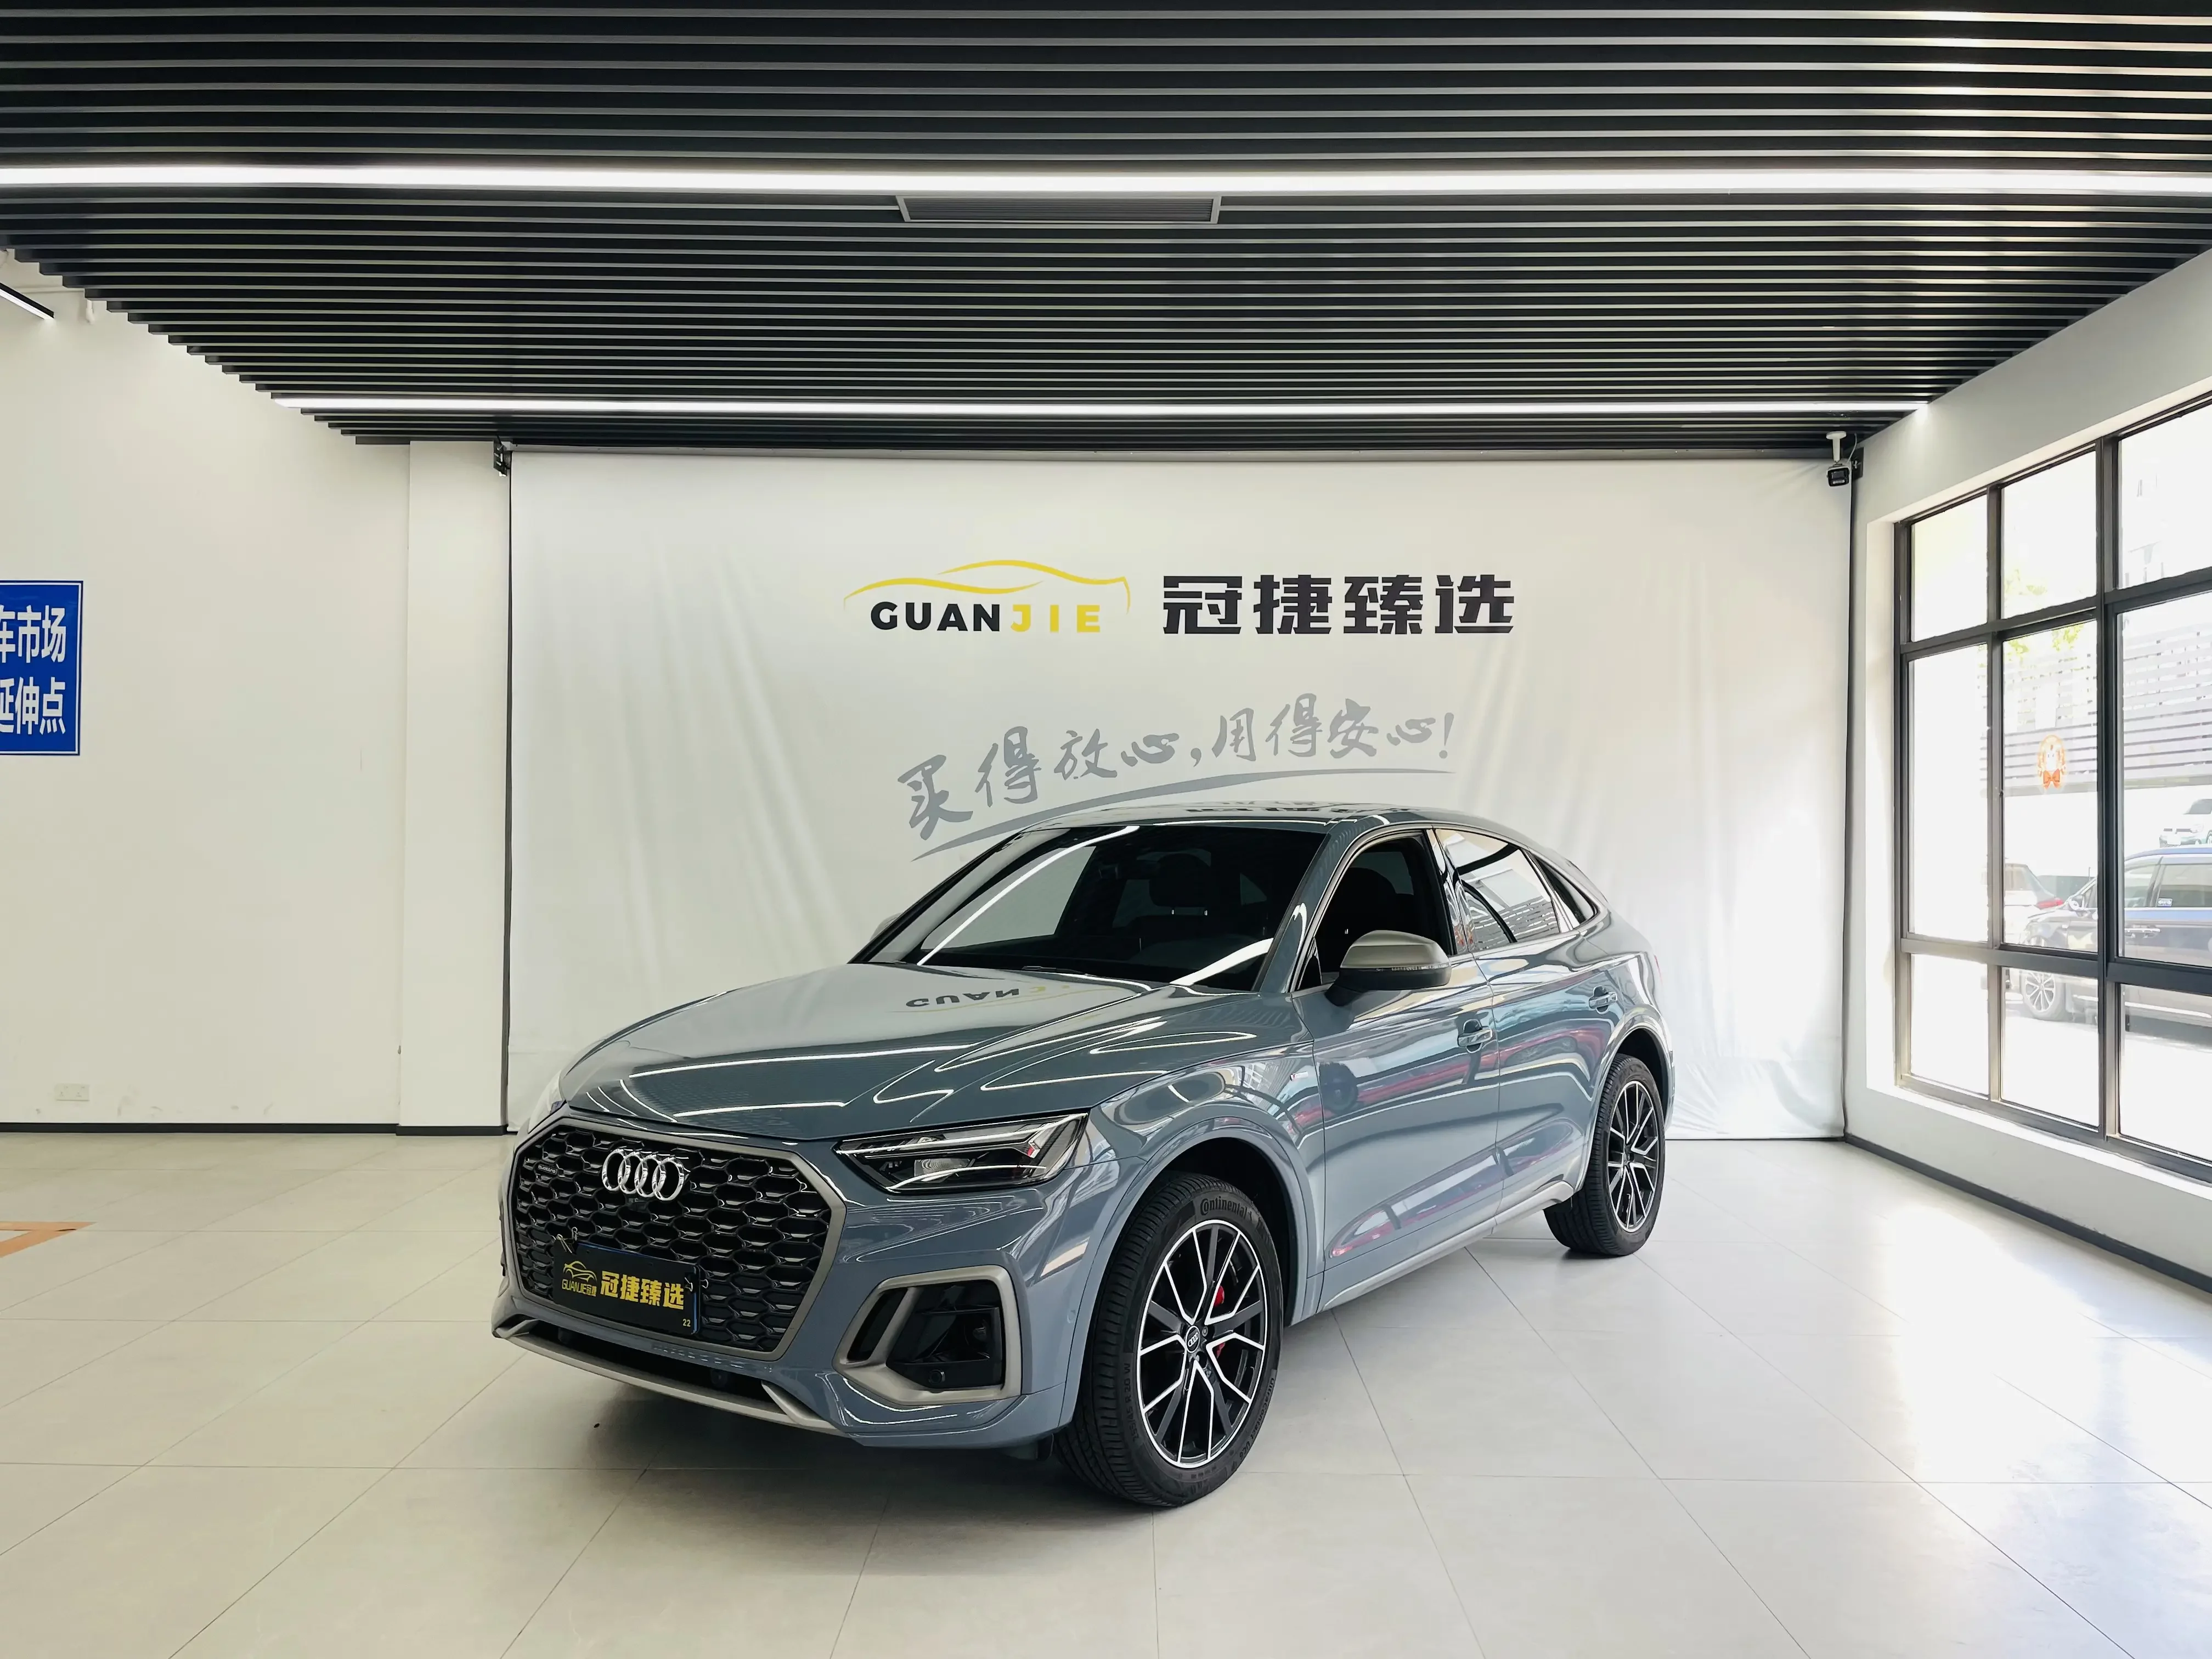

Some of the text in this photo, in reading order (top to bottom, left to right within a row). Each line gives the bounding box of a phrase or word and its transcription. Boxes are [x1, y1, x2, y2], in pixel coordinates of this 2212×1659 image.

[871, 601, 1101, 633] GUANJIE
[1163, 574, 1515, 635] 冠捷臻选
[1200, 1195, 1248, 1220] Continental
[600, 1271, 684, 1310] 冠捷臻选
[682, 1318, 691, 1327] 22
